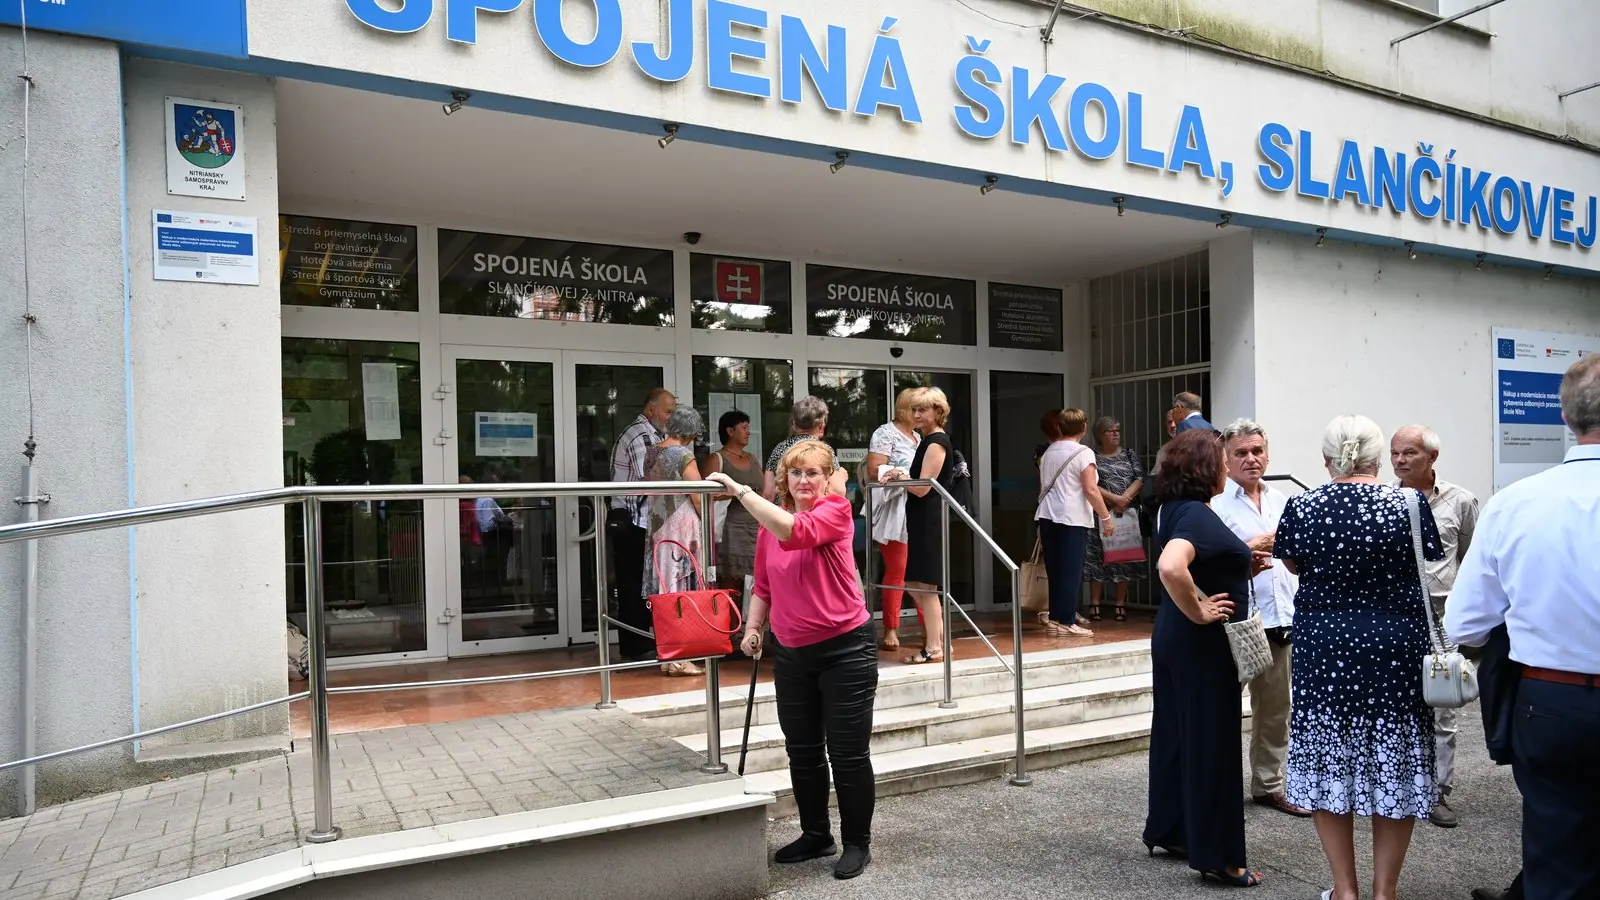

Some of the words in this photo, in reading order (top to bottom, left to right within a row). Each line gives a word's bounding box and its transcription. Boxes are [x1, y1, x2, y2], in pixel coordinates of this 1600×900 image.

[953, 34, 1234, 198] ŠKOLA,
[1257, 121, 1598, 248] SLANČÍKOVEJ
[189, 170, 224, 178] NITRIANSKY
[283, 224, 321, 236] Stredná
[323, 228, 382, 242] priemyselná
[384, 231, 408, 243] škola
[314, 241, 379, 254] potravinárska
[300, 255, 344, 266] Hotelová
[346, 257, 392, 270] akadémia
[473, 252, 575, 279] SPOJENÁ
[580, 256, 648, 285] ŠKOLA
[292, 270, 331, 281] Stredná
[333, 272, 375, 285] športová
[377, 275, 401, 286] škola
[319, 287, 376, 299] Gymnázium
[488, 280, 577, 299] SLANČÍKOVEJ
[597, 289, 637, 303] NITRA
[827, 283, 901, 305] SPOJENÁ
[905, 286, 954, 310] ŠKOLA
[838, 307, 904, 323] SLANČÍKOVEJ
[917, 313, 946, 326] NITRA
